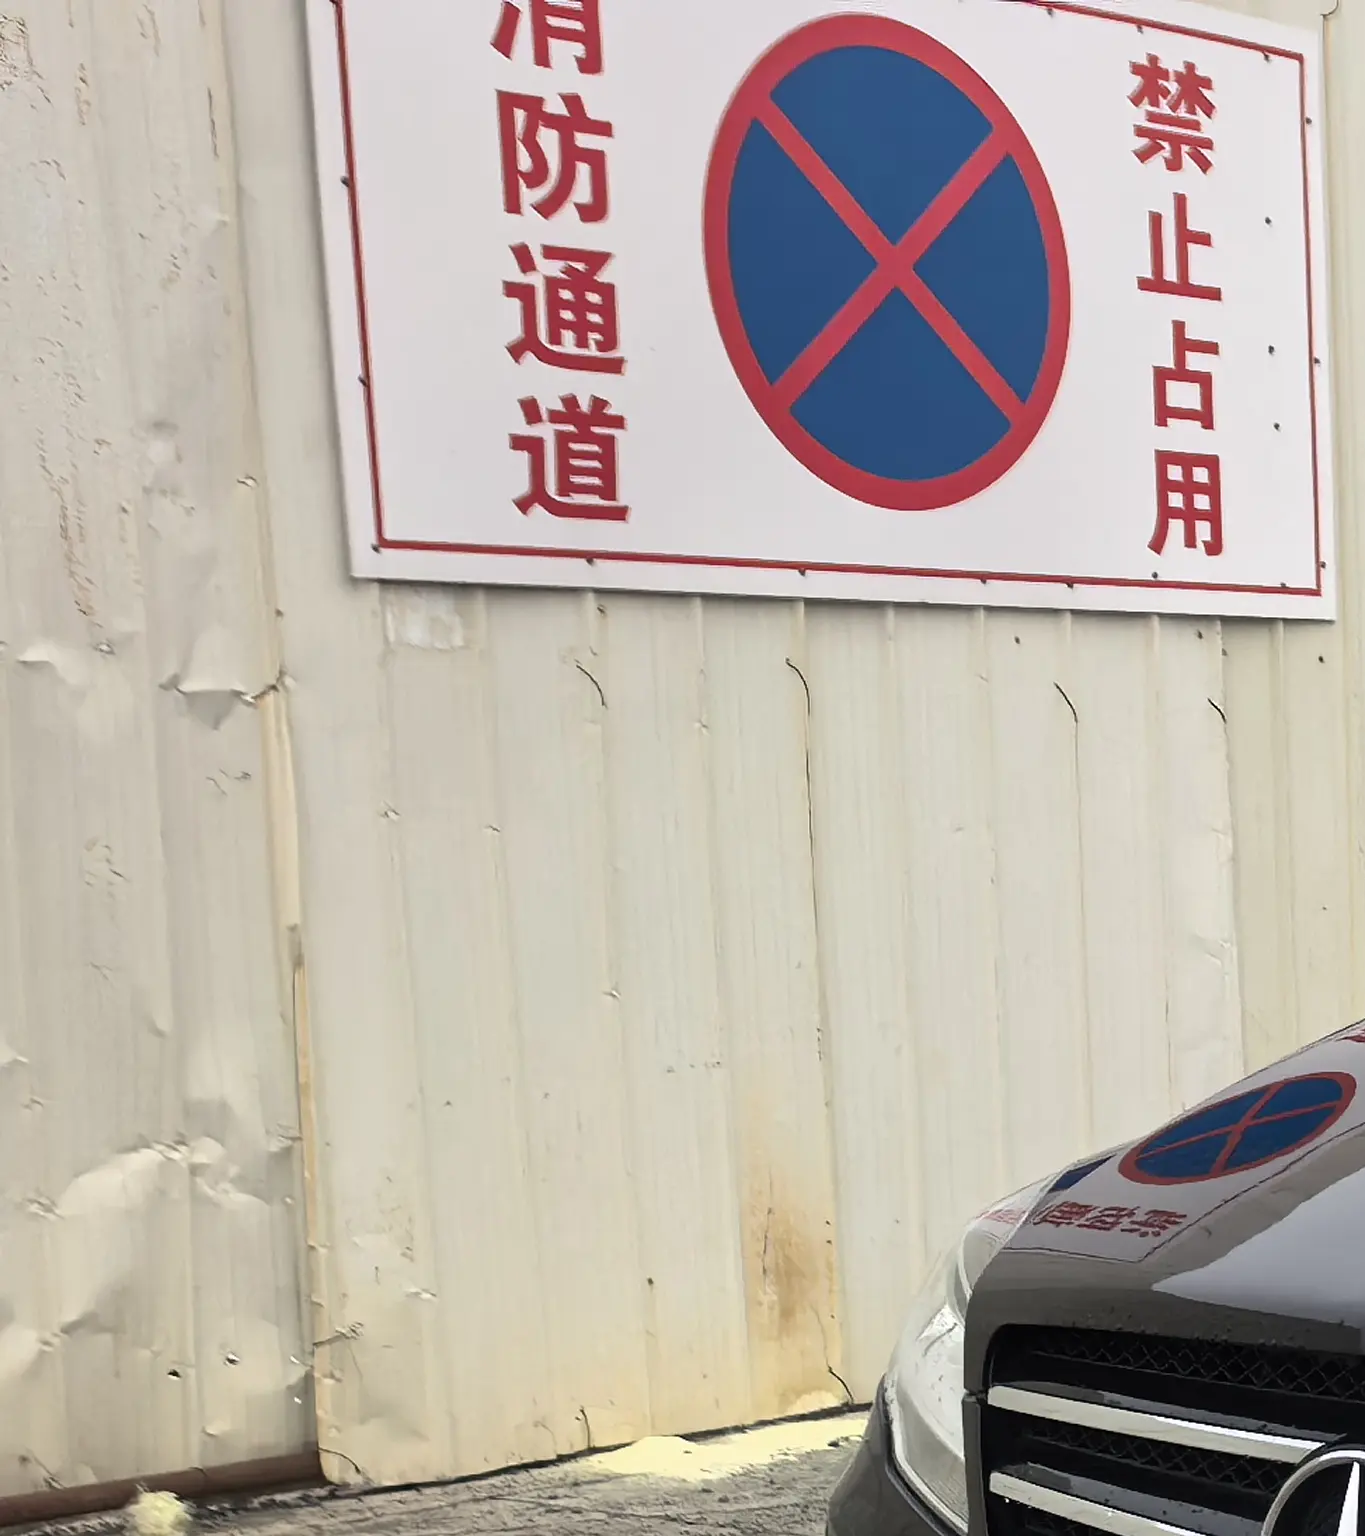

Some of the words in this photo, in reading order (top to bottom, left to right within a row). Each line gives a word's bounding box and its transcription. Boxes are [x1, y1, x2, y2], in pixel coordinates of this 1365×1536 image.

[490, 0, 630, 520] 消防通道
[1127, 53, 1225, 557] 禁止占用
